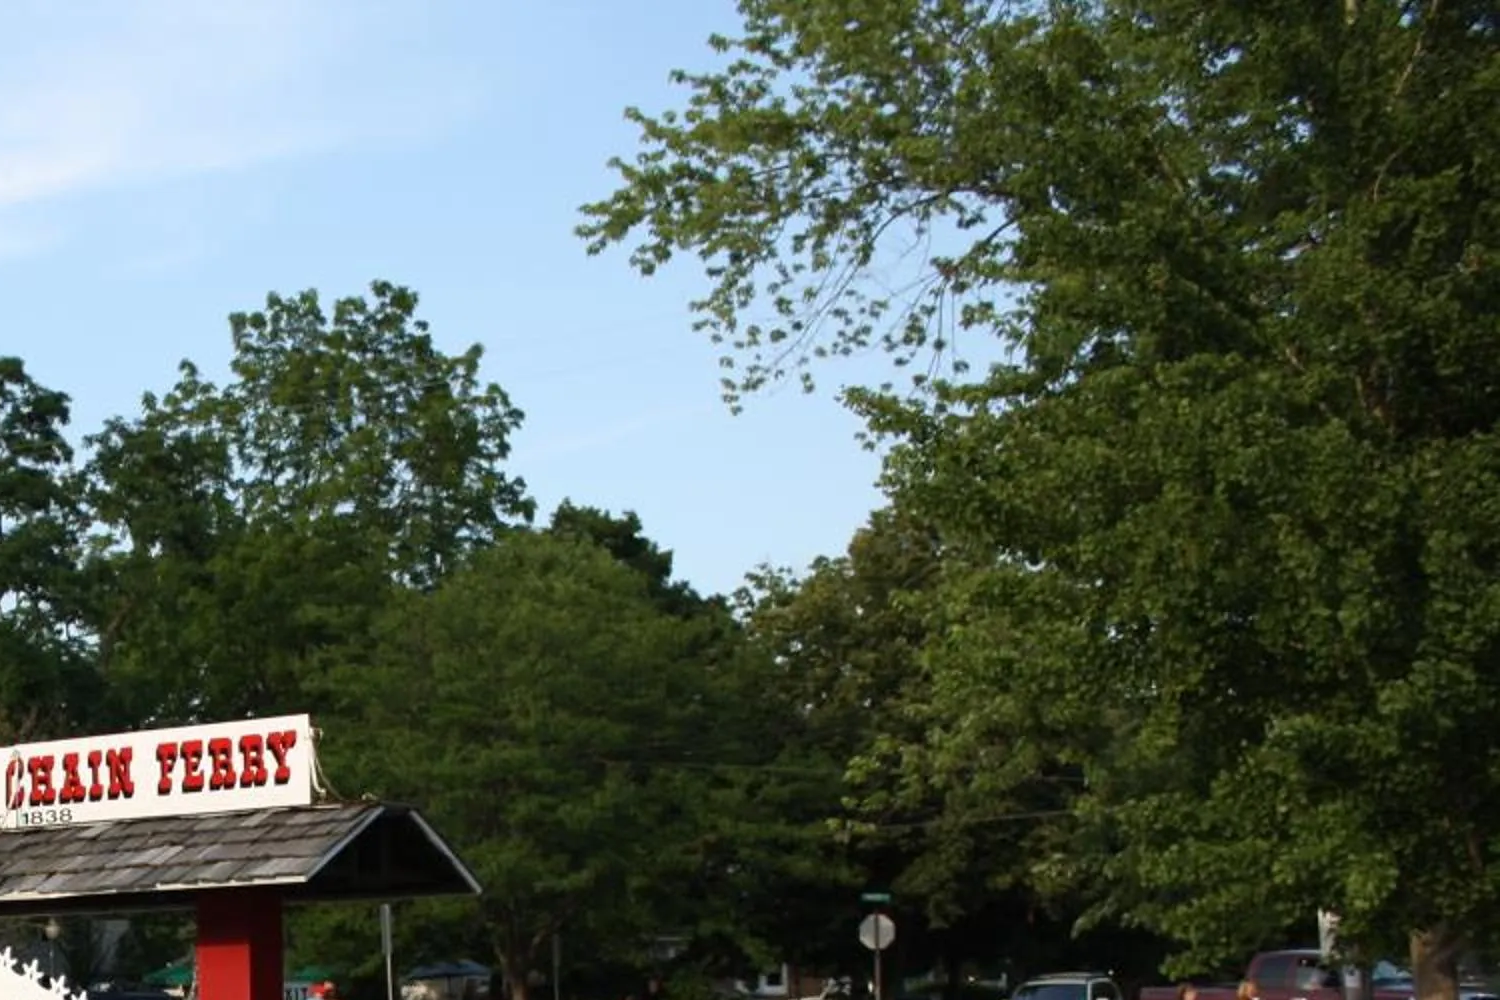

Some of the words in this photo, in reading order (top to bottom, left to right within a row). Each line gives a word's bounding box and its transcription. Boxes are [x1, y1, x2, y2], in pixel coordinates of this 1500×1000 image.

[6, 747, 135, 811] CHAIN
[156, 730, 297, 796] FERRY
[21, 807, 73, 825] 1838
[284, 987, 308, 1000] XIT
